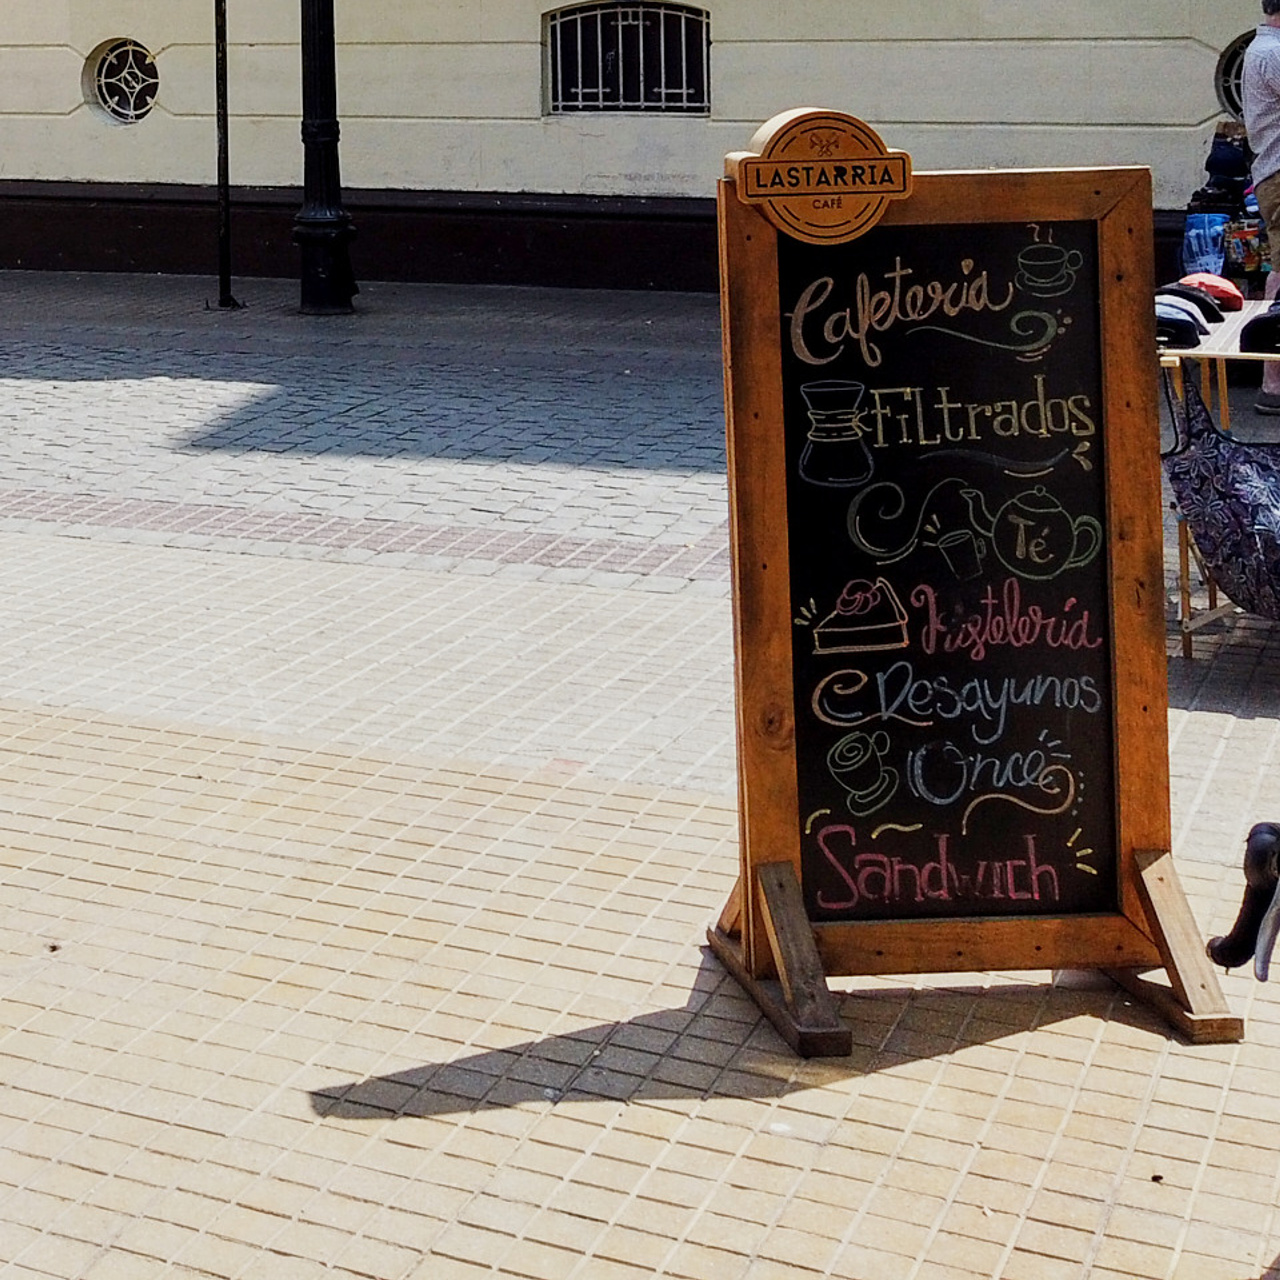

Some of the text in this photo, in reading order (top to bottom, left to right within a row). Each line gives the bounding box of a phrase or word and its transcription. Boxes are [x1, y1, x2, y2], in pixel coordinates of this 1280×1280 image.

[755, 165, 894, 188] LASTARRIA
[812, 196, 843, 209] CAFÉ
[1008, 515, 1054, 563] Té
[876, 661, 1102, 745] Desayunos
[908, 741, 1053, 805] Once
